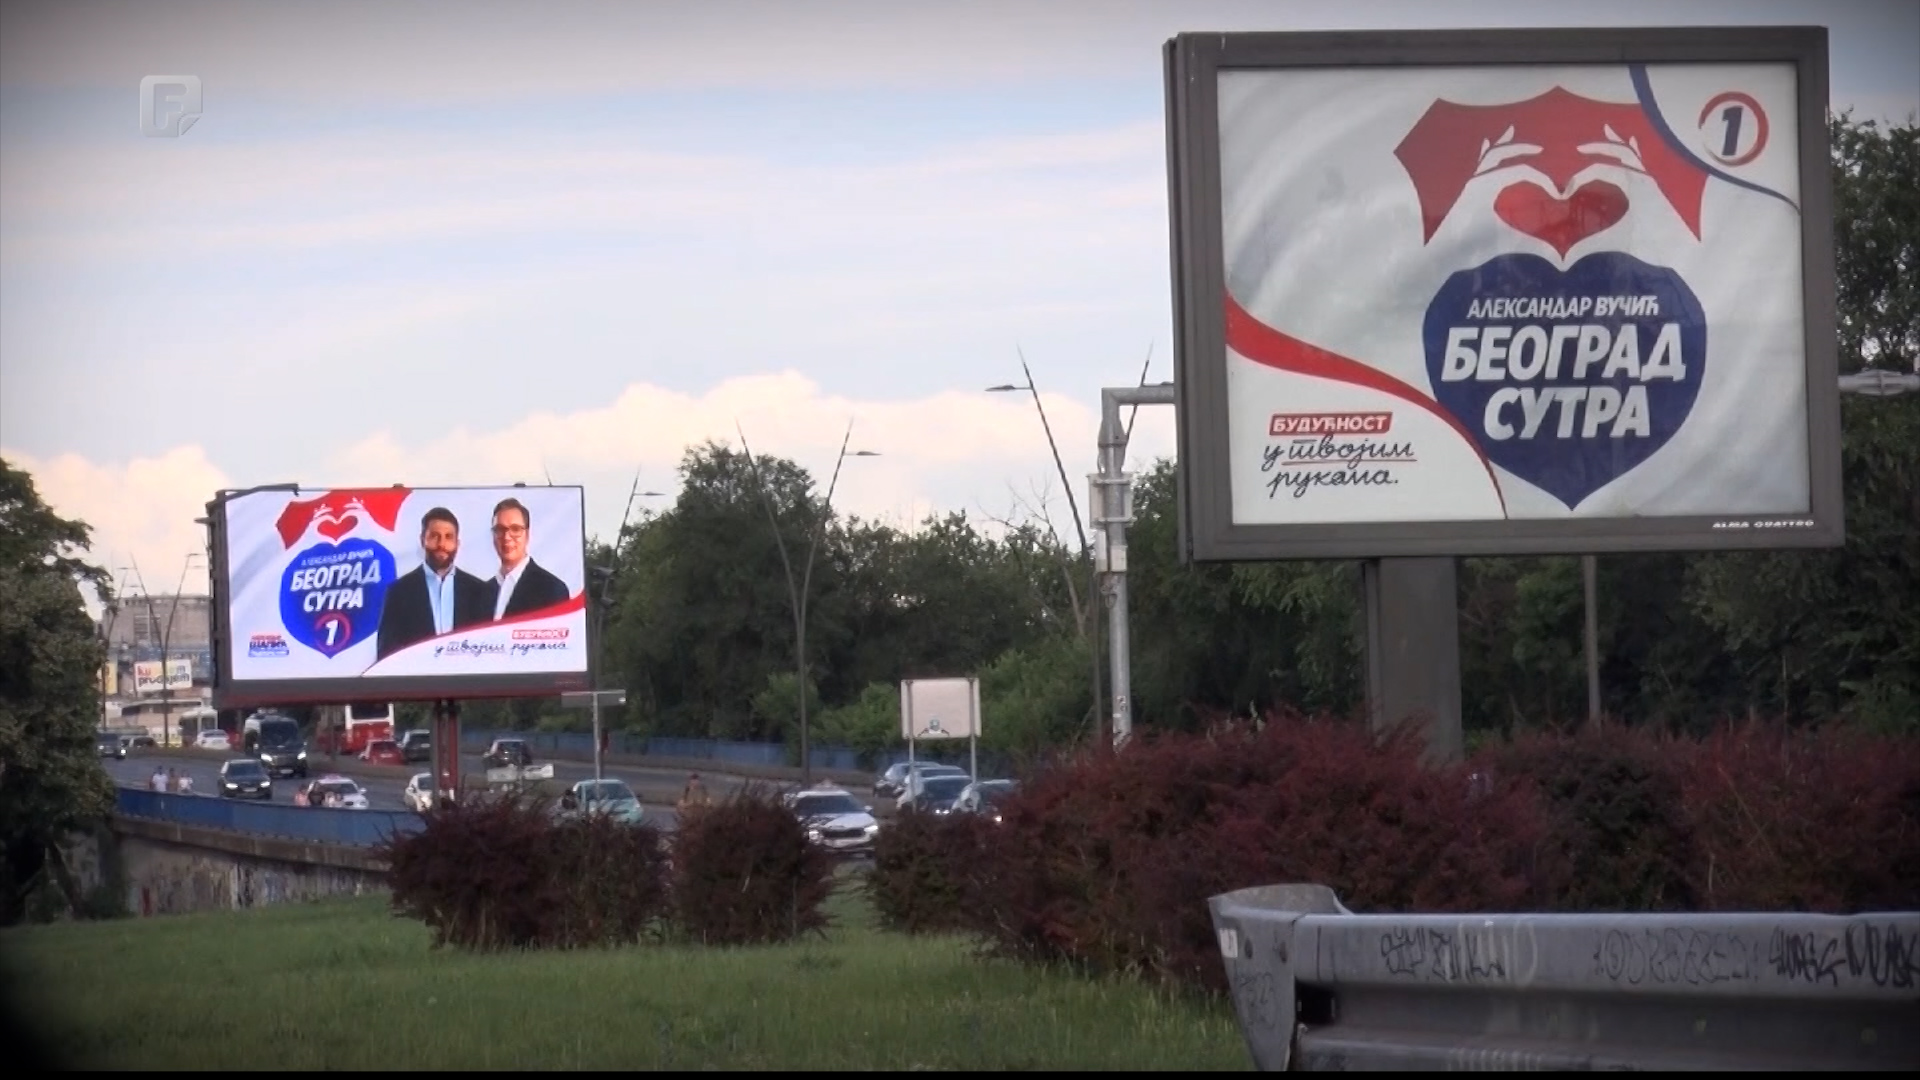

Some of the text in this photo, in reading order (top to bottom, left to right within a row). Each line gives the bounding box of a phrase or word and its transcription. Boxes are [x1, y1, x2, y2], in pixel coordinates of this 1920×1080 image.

[1722, 106, 1743, 156] 1
[1467, 295, 1659, 319] АЛЕКСАНДАР ВУЧИЋ
[1441, 323, 1687, 382] БЕОГРАД
[1272, 414, 1388, 433] БУДУЋНОСТ
[1484, 385, 1651, 441] СУТРА
[1261, 444, 1284, 472] у
[1712, 519, 1815, 529] ALMA QUATTRO
[290, 559, 381, 592] БЕОГРАД
[303, 587, 364, 612] СУТРА
[323, 619, 340, 647] 1
